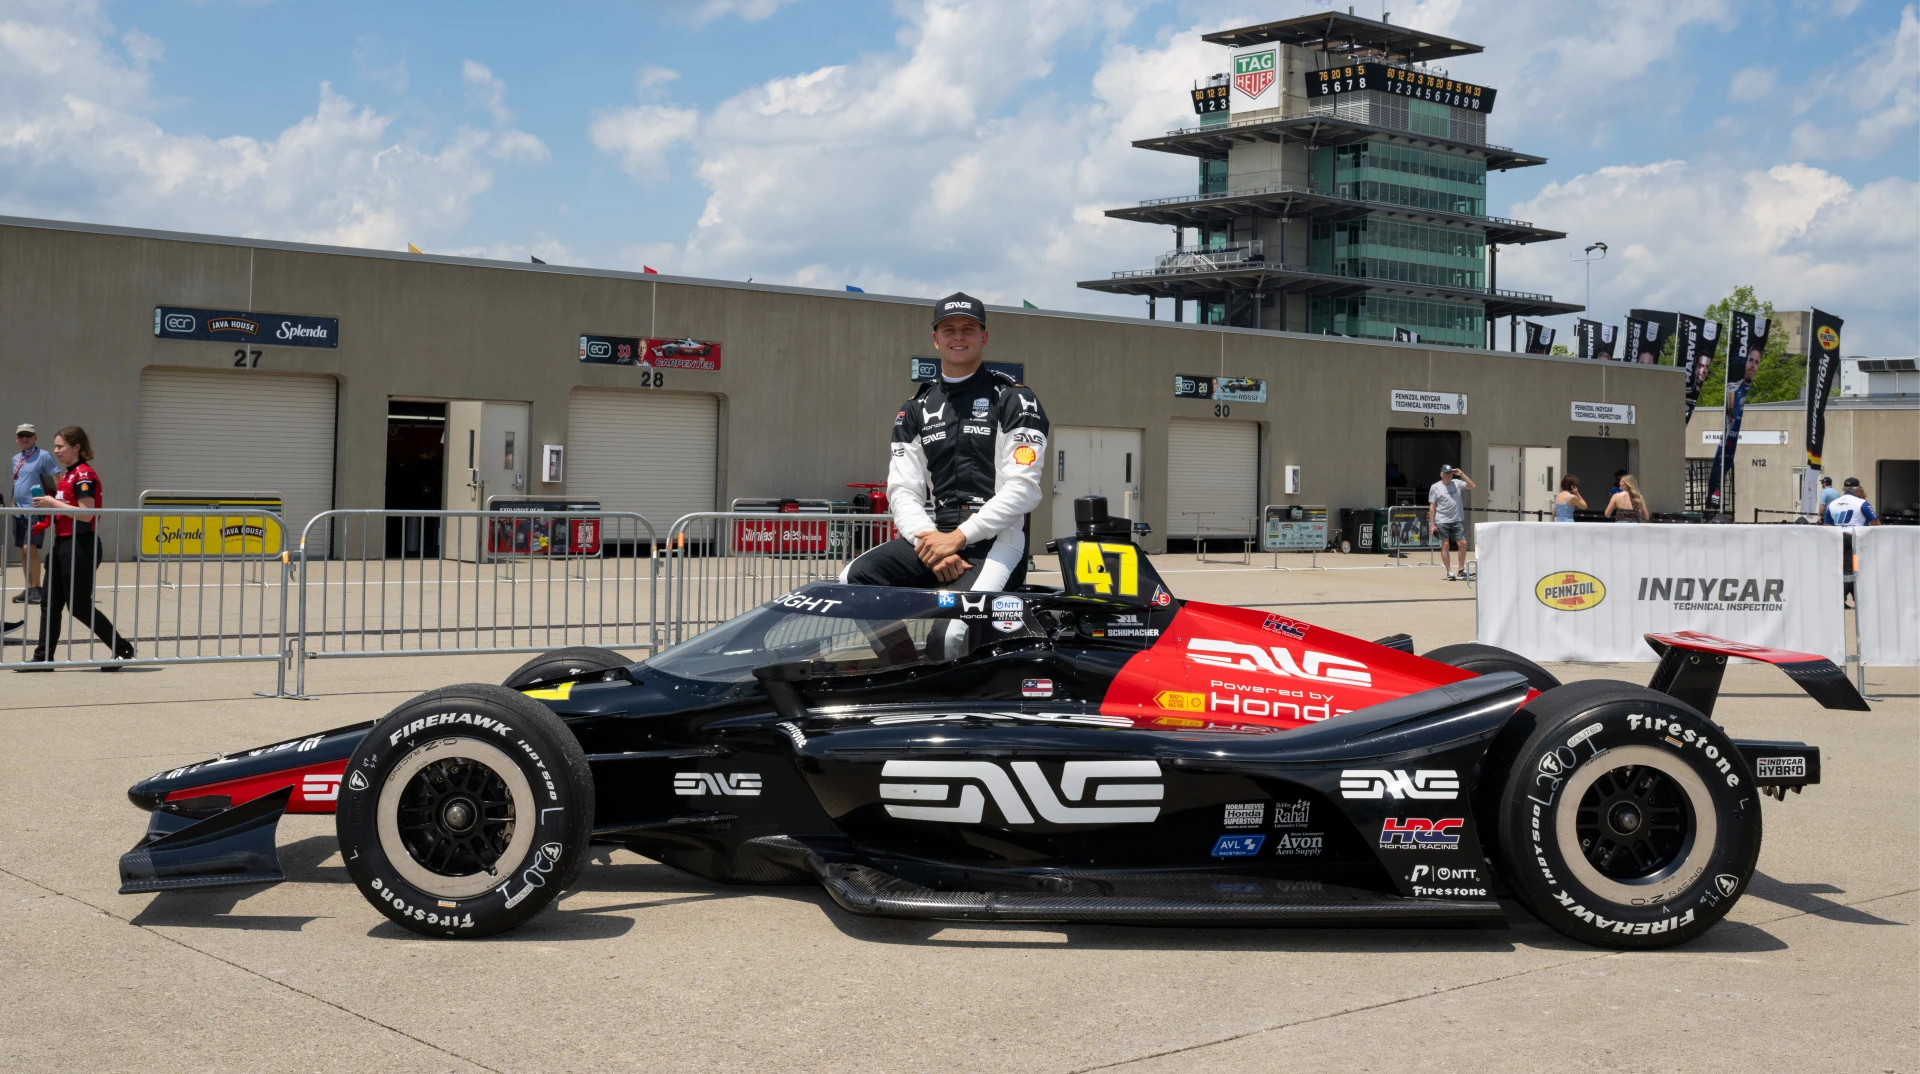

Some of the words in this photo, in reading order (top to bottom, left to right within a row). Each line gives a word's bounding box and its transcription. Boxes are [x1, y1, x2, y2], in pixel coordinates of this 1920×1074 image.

[1238, 54, 1272, 72] TAG
[1319, 71, 1328, 81] 76
[1332, 69, 1341, 79] 20
[1345, 68, 1352, 77] 9
[1358, 65, 1365, 75] 5
[1237, 72, 1274, 97] HEUER
[1321, 83, 1328, 94] 5
[1334, 81, 1341, 92] 6
[1347, 79, 1353, 91] 7
[1359, 77, 1366, 88] 8
[1387, 68, 1395, 78] 60
[1398, 71, 1404, 80] 12
[1407, 73, 1414, 82] 23
[1418, 75, 1423, 84] 3
[1427, 76, 1434, 86] 76
[1436, 79, 1443, 88] 20
[1447, 81, 1452, 90] 9
[1456, 83, 1461, 92] 5
[1465, 86, 1471, 94] 14
[1474, 87, 1481, 97] 33
[1195, 90, 1204, 100] 60
[1207, 88, 1215, 98] 12
[1218, 87, 1227, 97] 23
[1387, 81, 1391, 91] 1
[1396, 83, 1402, 93] 2
[1406, 85, 1412, 95] 3
[1416, 87, 1421, 97] 4
[1425, 89, 1431, 99] 5
[1435, 91, 1440, 101] 6
[1445, 93, 1450, 103] 7
[1454, 95, 1459, 105] 8
[1464, 97, 1469, 107] 9
[1472, 99, 1480, 109] 10
[1199, 102, 1203, 113] 1
[1209, 100, 1216, 111] 2
[1220, 99, 1227, 109] 3
[212, 321, 229, 330] JAVA
[231, 320, 256, 332] HOUSE
[276, 321, 328, 340] Splenda
[1739, 317, 1749, 358] DALY
[233, 349, 263, 368] 27
[618, 344, 631, 357] 33
[1685, 320, 1697, 383] HARVEY
[655, 358, 715, 370] CARPENTER
[641, 371, 664, 388] 28
[1199, 383, 1207, 393] 20
[1395, 401, 1421, 409] TECHNICAL
[1811, 353, 1830, 445] INSPECTION
[1018, 412, 1041, 420] Honda
[1214, 404, 1230, 418] 30
[922, 422, 946, 431] Honda
[1424, 416, 1434, 428] 31
[1599, 426, 1610, 436] 32
[1752, 459, 1767, 467] N12
[1076, 541, 1138, 596] 47
[1544, 582, 1597, 600] PENNZOIL
[1638, 577, 1785, 602] INDYCAR
[939, 595, 954, 605] PPG
[1673, 602, 1725, 611] TECHNICAL
[1726, 603, 1783, 612] INSPECTION
[1108, 629, 1160, 637] SCHUMACHER
[1211, 679, 1303, 698] Powered
[1309, 692, 1334, 702] by
[389, 712, 513, 747] FIREHAWK
[1627, 714, 1740, 787] Firestone
[388, 749, 421, 782] RACING
[1274, 806, 1309, 823] Rahal
[1379, 818, 1464, 843] HRC
[1220, 841, 1240, 849] AVL
[1277, 834, 1322, 849] Avon
[1276, 848, 1294, 856] Aero
[1295, 847, 1322, 856] Supply
[1452, 869, 1477, 879] NTT
[1668, 866, 1704, 897] RACING
[1412, 885, 1487, 896] Firestone
[371, 878, 475, 928] Firestone
[1552, 889, 1695, 936] FIREHAWK
